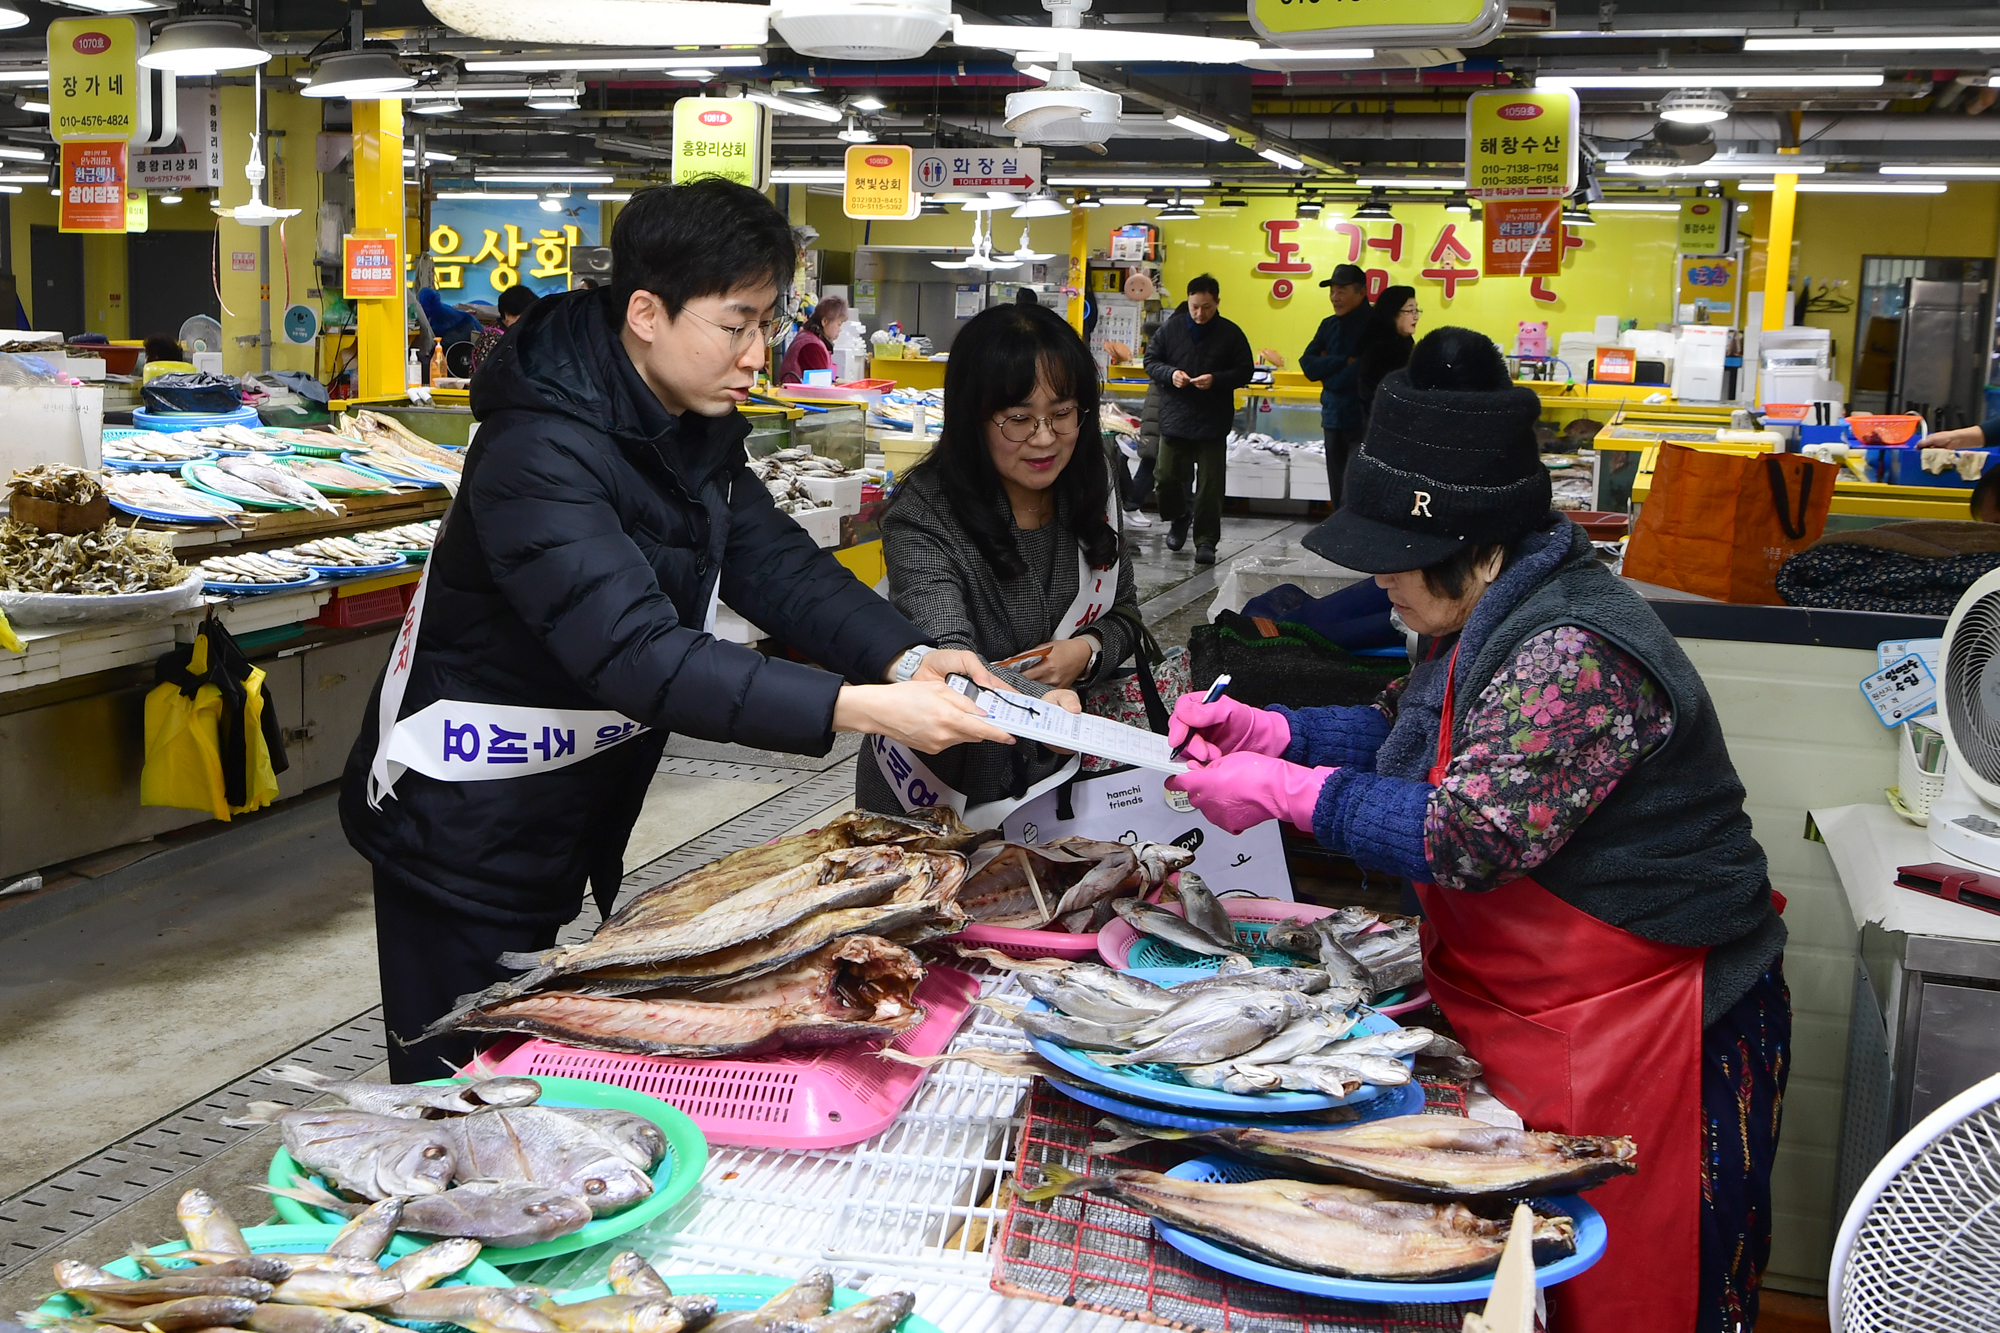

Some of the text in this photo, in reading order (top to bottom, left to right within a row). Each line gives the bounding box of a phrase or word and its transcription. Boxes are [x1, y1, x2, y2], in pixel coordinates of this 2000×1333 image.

[79, 38, 104, 49] 1070호
[63, 75, 123, 97] 장가네
[1505, 106, 1536, 116] 1059호
[60, 115, 129, 127] 010-4576-4824
[208, 104, 219, 180] 흥왕리상회
[682, 140, 746, 158] 흥왕리상회
[1480, 136, 1560, 155] 해창수산
[137, 158, 198, 173] 흥왕리상회
[953, 158, 1017, 175] 화장실
[1482, 164, 1559, 174] 010-7138-1794
[75, 166, 116, 183] 환급행사
[1482, 175, 1558, 186] 010-3855-6154
[855, 177, 901, 191] 햇빛상회
[69, 186, 120, 204] 참여점포
[851, 196, 902, 204] 032)933-8453
[1499, 222, 1547, 236] 환급행사
[1492, 238, 1552, 253] 참여점포
[356, 255, 388, 267] 환급행사
[406, 223, 581, 292] 음상회
[351, 268, 392, 280] 참여점포
[1106, 306, 1112, 316] 2
[1411, 490, 1433, 518] R
[1895, 673, 1919, 692] 수입
[1872, 686, 1893, 701] 원산지
[1106, 784, 1142, 800] hamchi
[1109, 796, 1144, 810] friends
[1178, 831, 1198, 852] ow
